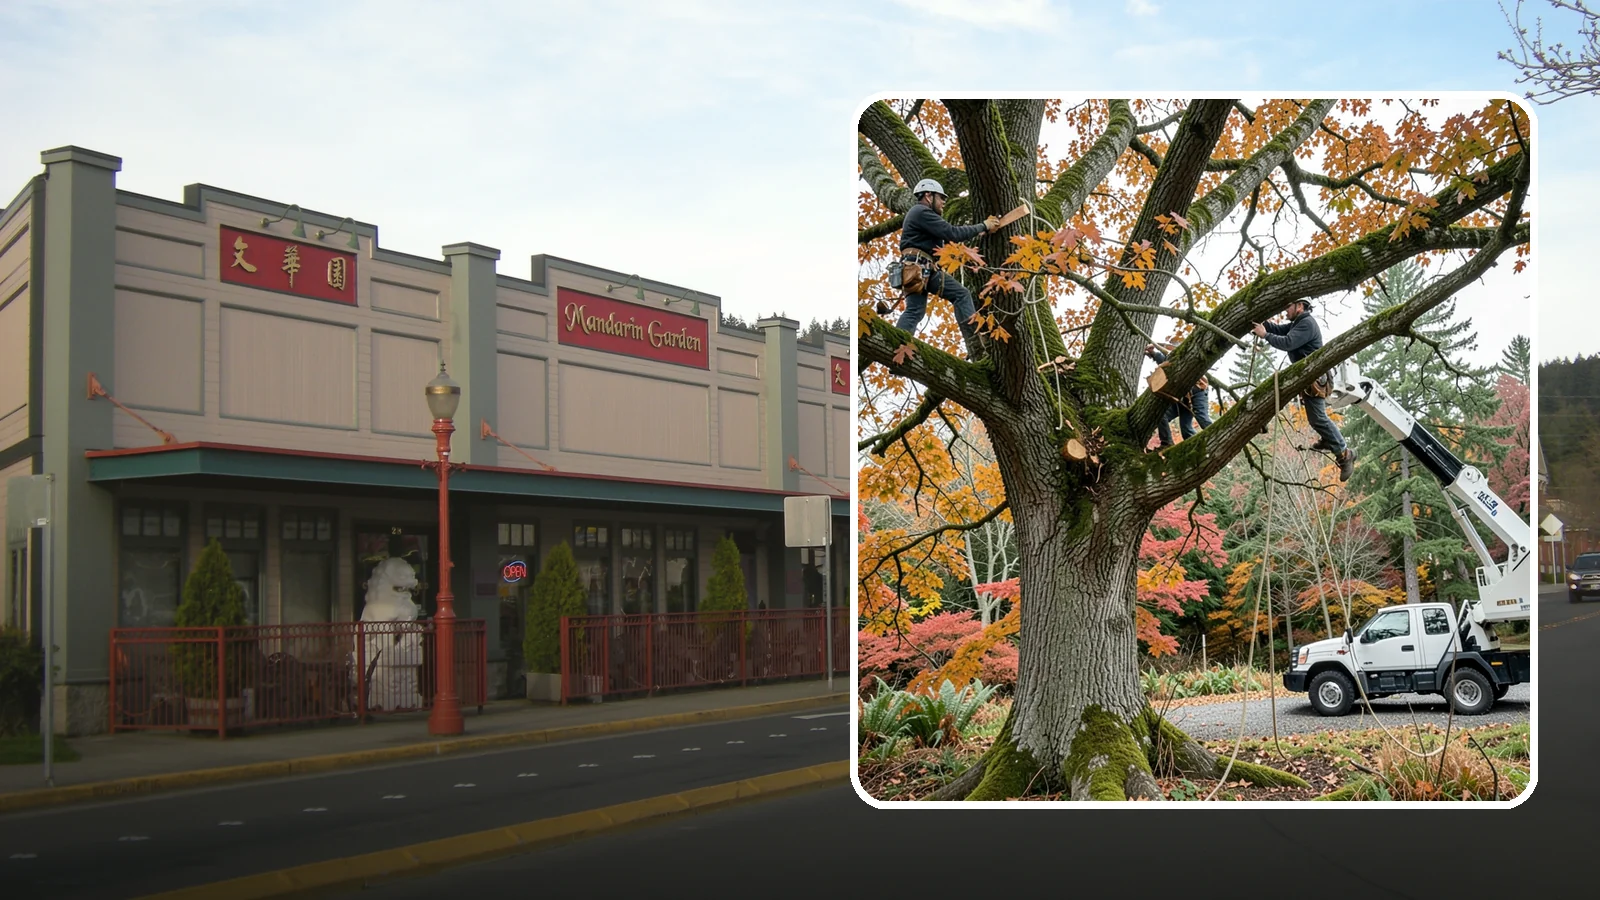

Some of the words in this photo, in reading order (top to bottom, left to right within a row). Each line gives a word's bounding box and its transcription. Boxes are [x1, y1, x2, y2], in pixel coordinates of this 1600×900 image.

[230, 235, 347, 291] 文華園
[564, 302, 644, 341] Mandarin
[647, 320, 702, 352] Garden
[503, 565, 527, 578] OPEN
